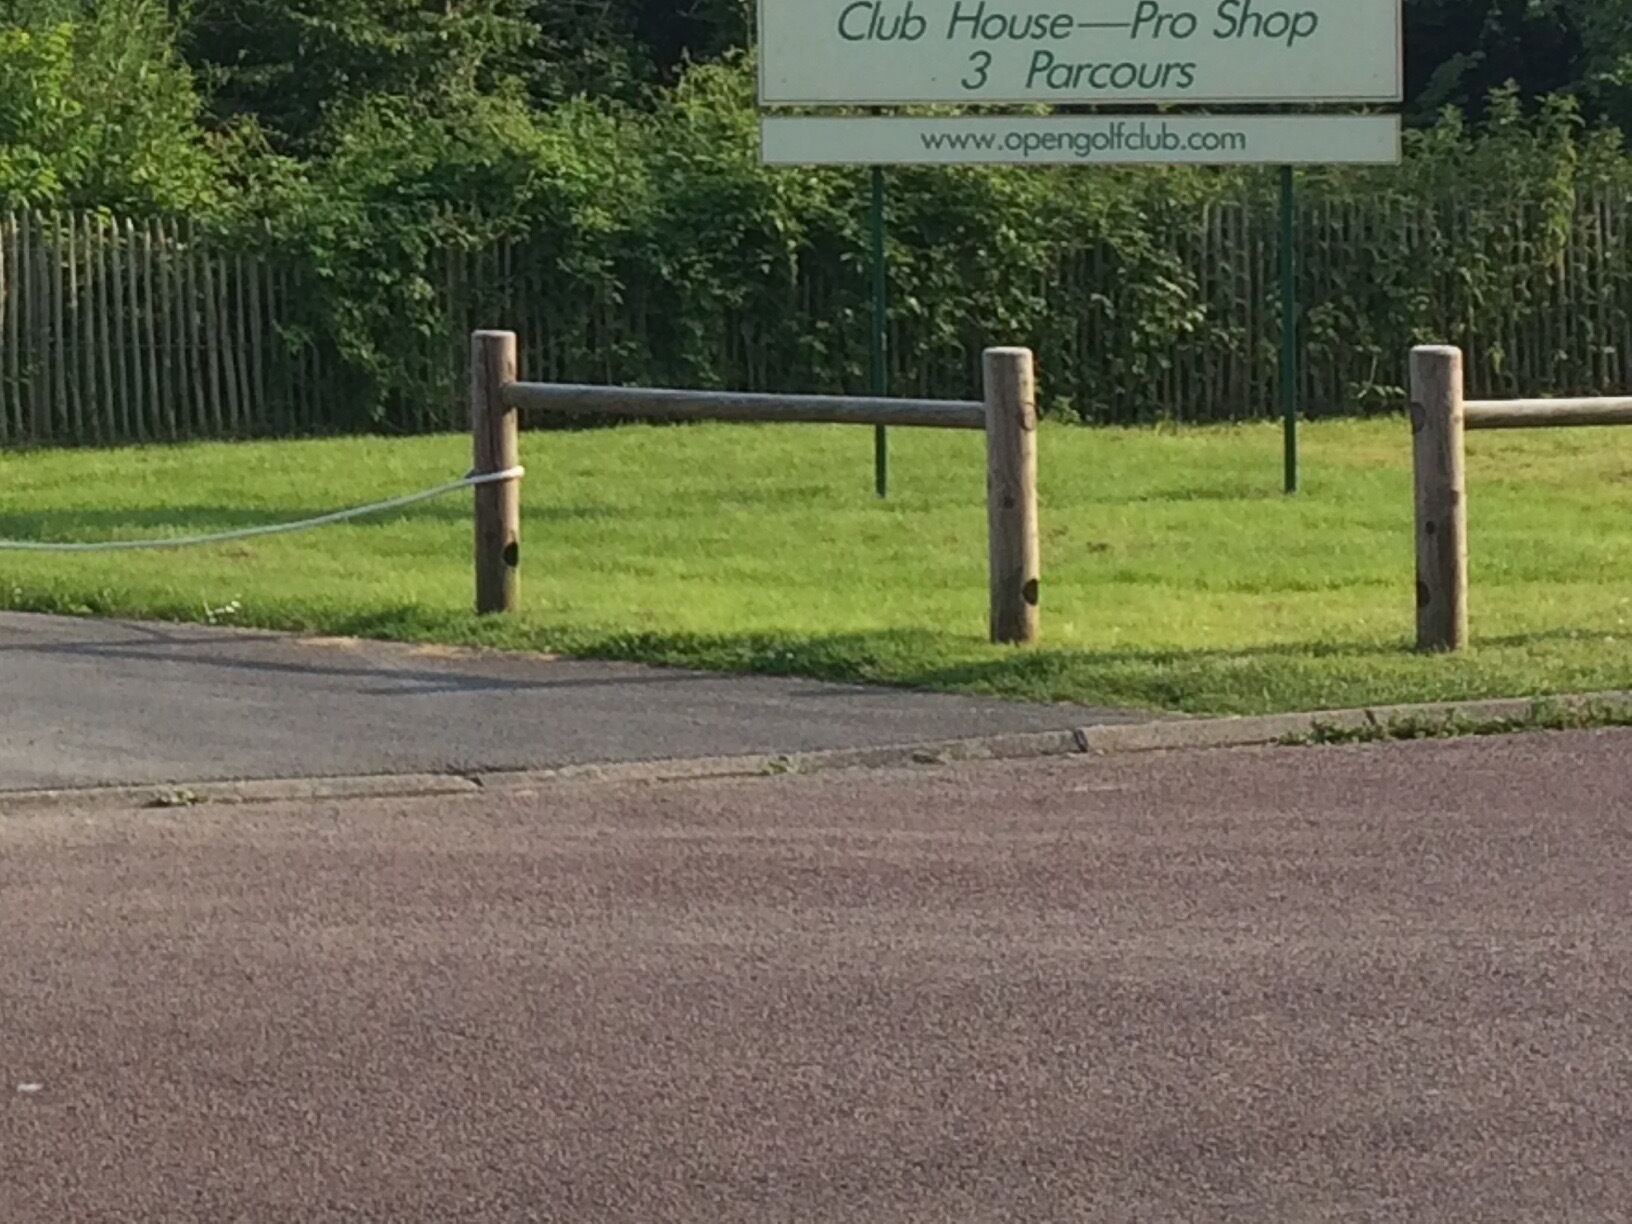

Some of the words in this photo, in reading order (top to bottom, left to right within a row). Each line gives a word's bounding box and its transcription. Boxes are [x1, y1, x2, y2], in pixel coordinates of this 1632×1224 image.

[837, 1, 927, 43] Club
[961, 49, 992, 90] 3
[1025, 49, 1197, 90] Parcours
[920, 121, 1247, 159] www.opengolfclub.com
